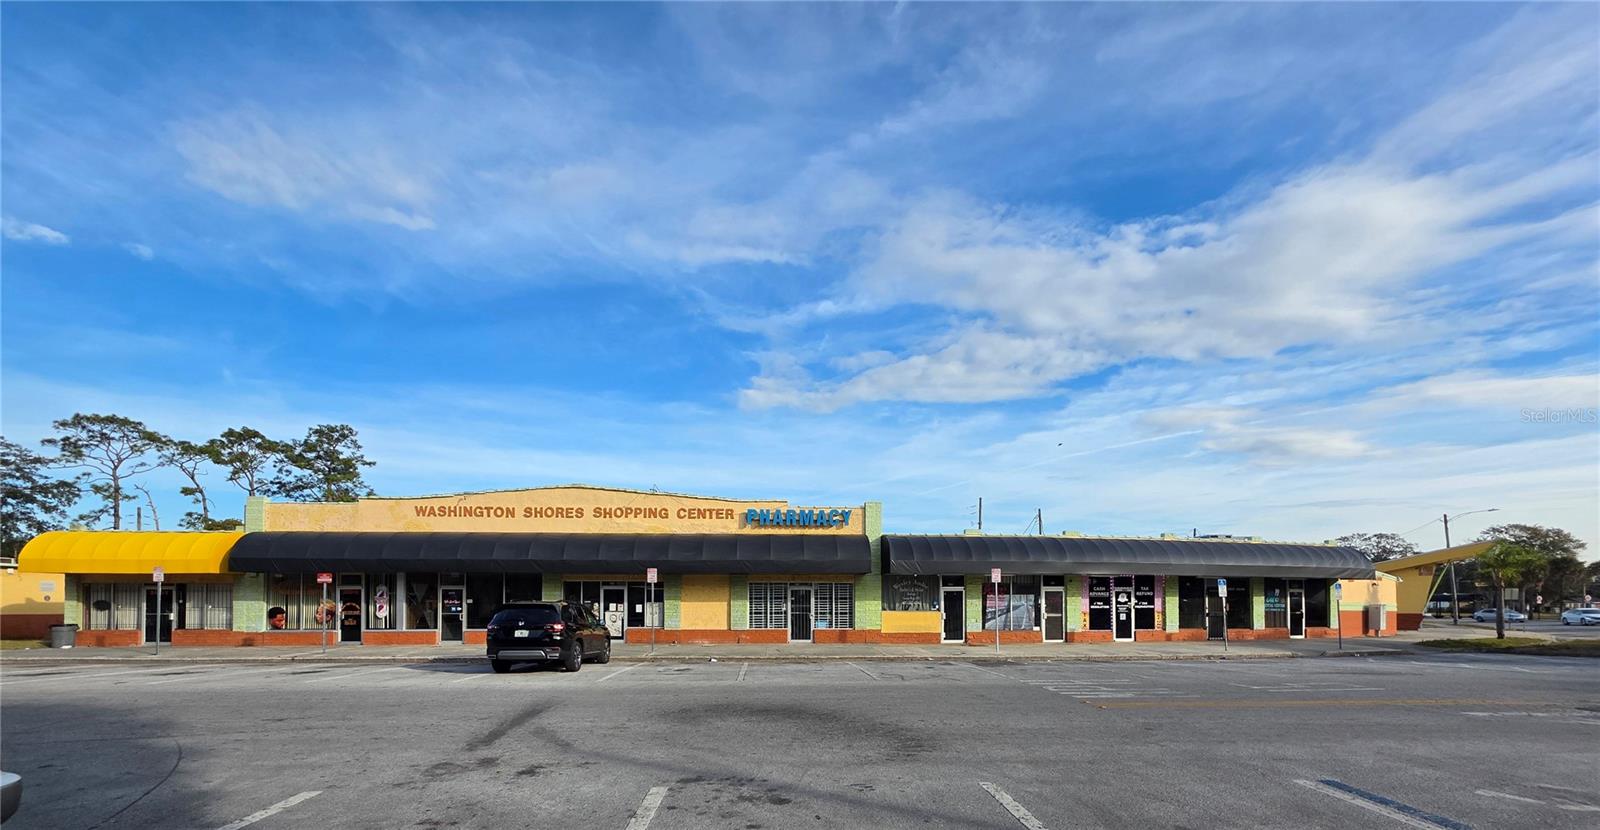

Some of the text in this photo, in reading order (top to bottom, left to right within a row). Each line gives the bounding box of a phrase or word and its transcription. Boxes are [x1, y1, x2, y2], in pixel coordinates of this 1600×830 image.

[415, 505, 735, 520] WASHINGTON SHORES SHOPPING CENTER
[745, 508, 853, 527] PHARMACY
